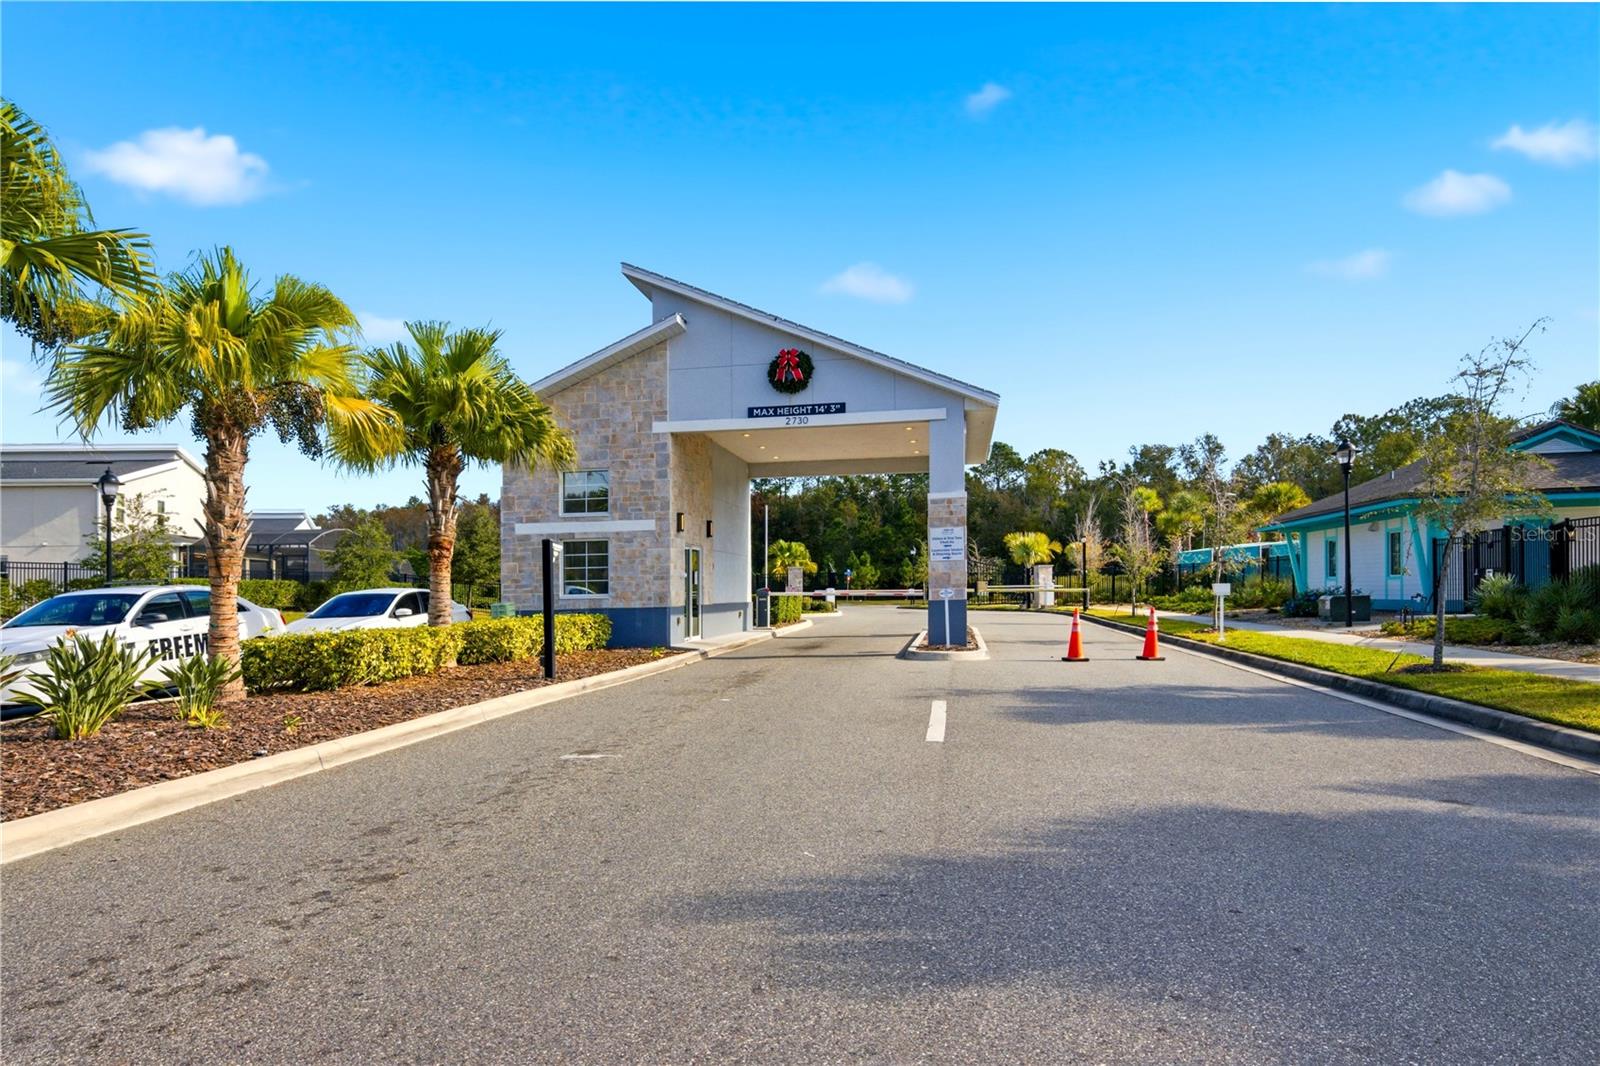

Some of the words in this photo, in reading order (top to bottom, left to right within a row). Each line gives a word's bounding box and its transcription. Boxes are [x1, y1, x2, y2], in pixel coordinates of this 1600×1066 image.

[753, 407, 775, 416] MAX
[776, 406, 812, 415] HEIGHT
[814, 405, 828, 413] 14'
[785, 416, 809, 425] 2730
